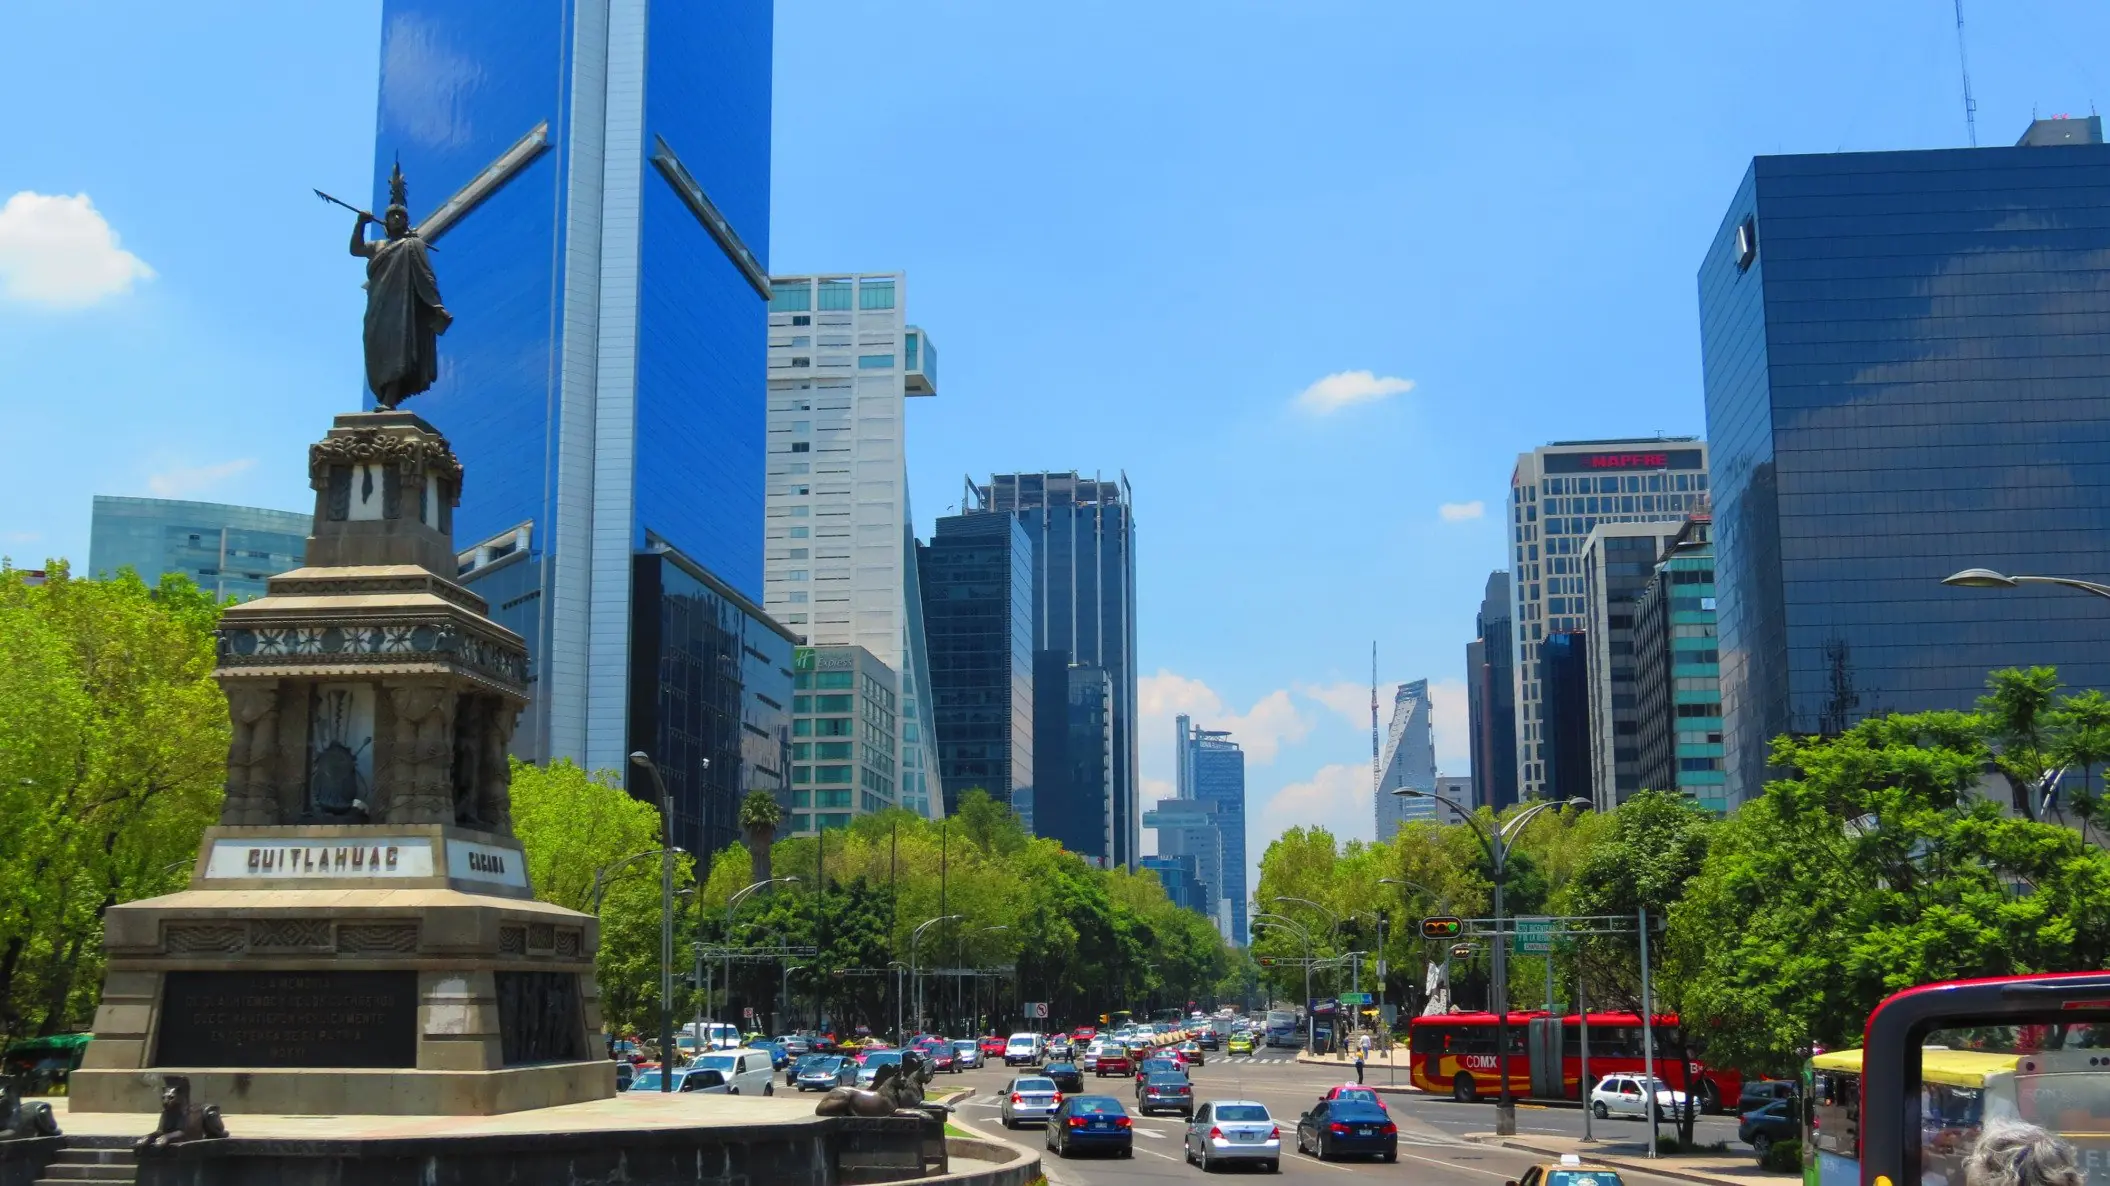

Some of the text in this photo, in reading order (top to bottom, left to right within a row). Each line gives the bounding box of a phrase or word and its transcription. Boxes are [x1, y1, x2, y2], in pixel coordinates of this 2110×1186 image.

[1592, 453, 1668, 468] MAPFRE
[248, 846, 399, 868] CUITLAHUAC
[1466, 1055, 1497, 1068] CDMX
